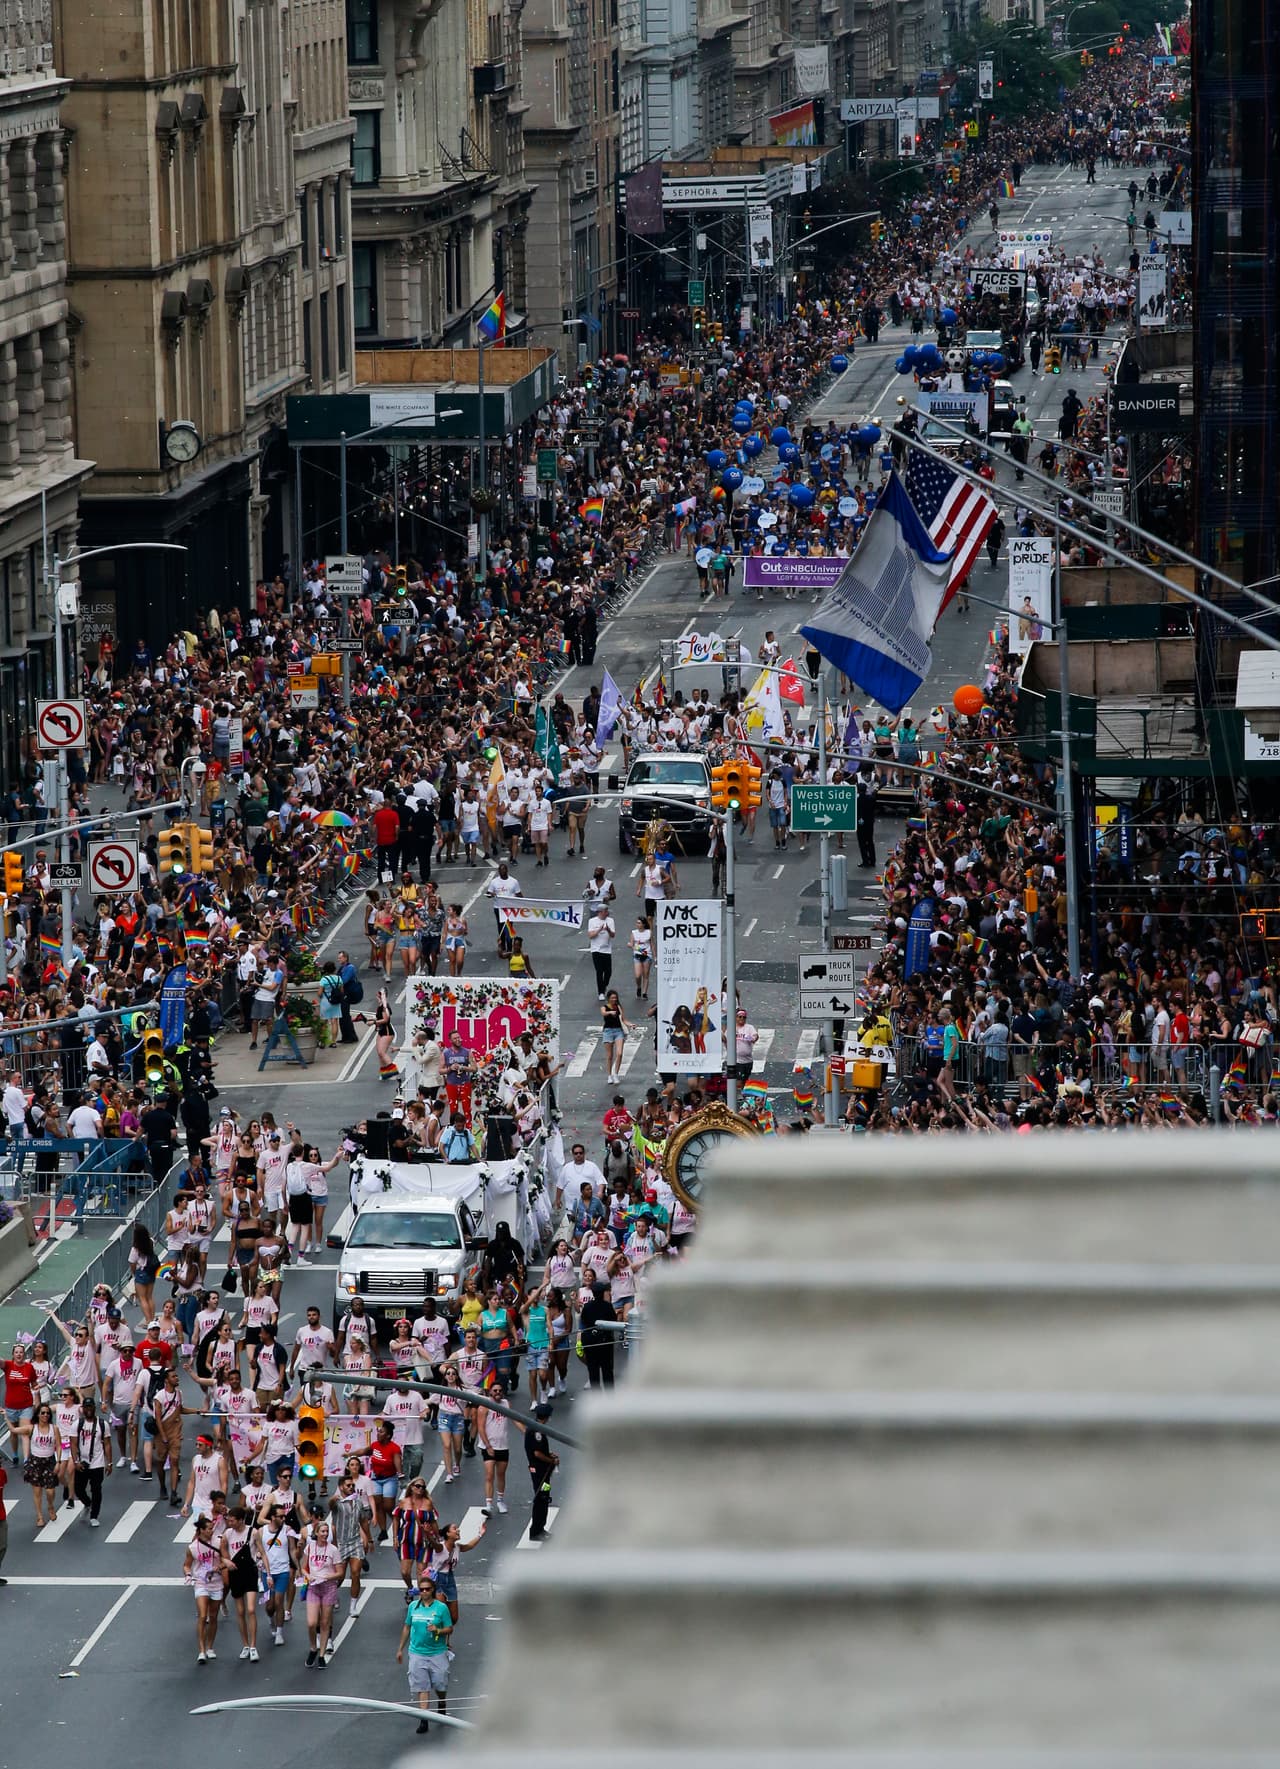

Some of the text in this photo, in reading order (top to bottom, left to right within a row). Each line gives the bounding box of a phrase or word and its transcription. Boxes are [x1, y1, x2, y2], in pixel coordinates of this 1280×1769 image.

[847, 103, 894, 116] ARITZIA
[672, 188, 718, 197] SEPHORA
[1141, 263, 1164, 272] PRIDE
[975, 272, 1019, 286] FACES
[1118, 399, 1176, 411] BANDIER
[1094, 494, 1122, 503] PASSENGER
[1013, 541, 1037, 552] NYC
[345, 561, 361, 569] TRUCK
[800, 575, 811, 583] Ally
[89, 604, 114, 614] LESS
[848, 607, 886, 640] HOLDING
[679, 634, 720, 664] Love
[886, 638, 924, 672] COMPANY
[796, 789, 852, 800] West Side
[800, 801, 848, 813] Highway
[51, 879, 82, 887] BIKE LANE
[501, 905, 581, 925] wework
[663, 905, 699, 921] NYC
[910, 920, 931, 929] NYPD
[837, 939, 868, 948] W 23 St
[663, 947, 706, 955] June 14-24
[663, 957, 681, 965] 2018
[829, 961, 852, 970] TRUCK
[829, 974, 852, 982] ROUTE
[163, 989, 185, 998] NYPD
[803, 1001, 827, 1009] LOCAL
[249, 1306, 266, 1316] PRIDE
[349, 1323, 367, 1333] PRIDE
[103, 1333, 121, 1343] PRIDE
[216, 1350, 232, 1359] PRIDE
[259, 1351, 273, 1361] PRIDE
[346, 1362, 363, 1370] PRIDE
[396, 1402, 413, 1411] PRIDE
[58, 1412, 75, 1422] PRIDE
[271, 1426, 290, 1436] PRIDE
[34, 1435, 53, 1445] PRIDE
[194, 1465, 212, 1475] PRIDE
[310, 1553, 329, 1563] PRIDE
